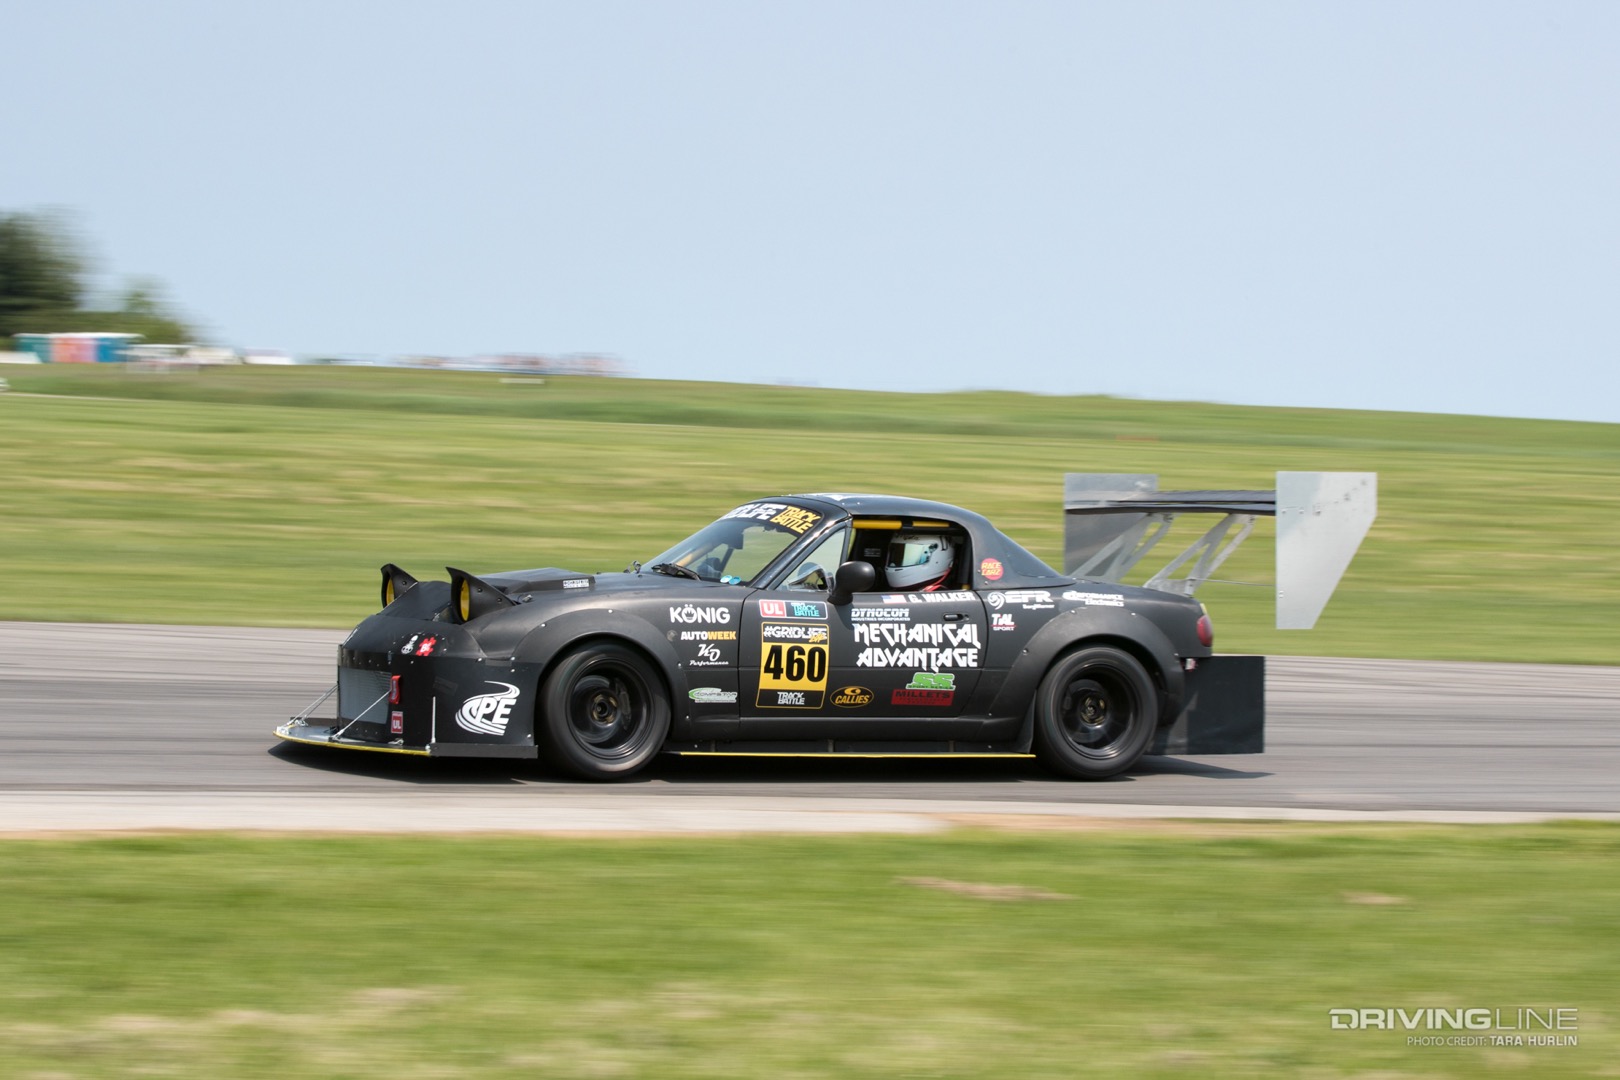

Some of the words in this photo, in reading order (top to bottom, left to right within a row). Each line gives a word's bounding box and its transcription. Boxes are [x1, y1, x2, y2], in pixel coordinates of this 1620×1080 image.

[782, 505, 822, 522] TRACK
[769, 514, 814, 534] BATTLE
[921, 592, 976, 602] WALKER
[763, 602, 784, 615] UL
[792, 603, 817, 611] TRACK
[794, 608, 820, 616] BATTLE
[851, 608, 909, 617] DYNOCOM
[669, 603, 731, 624] KÖNIG
[680, 631, 737, 641] AUTOWEEK
[763, 625, 828, 639] #GRIDLIFE
[852, 623, 981, 649] MECHANICAL
[763, 644, 827, 683] 460
[856, 647, 978, 673] ADVANTAGE
[777, 691, 804, 700] TRACK
[777, 697, 805, 705] BATTLE
[834, 695, 870, 705] CALLIES
